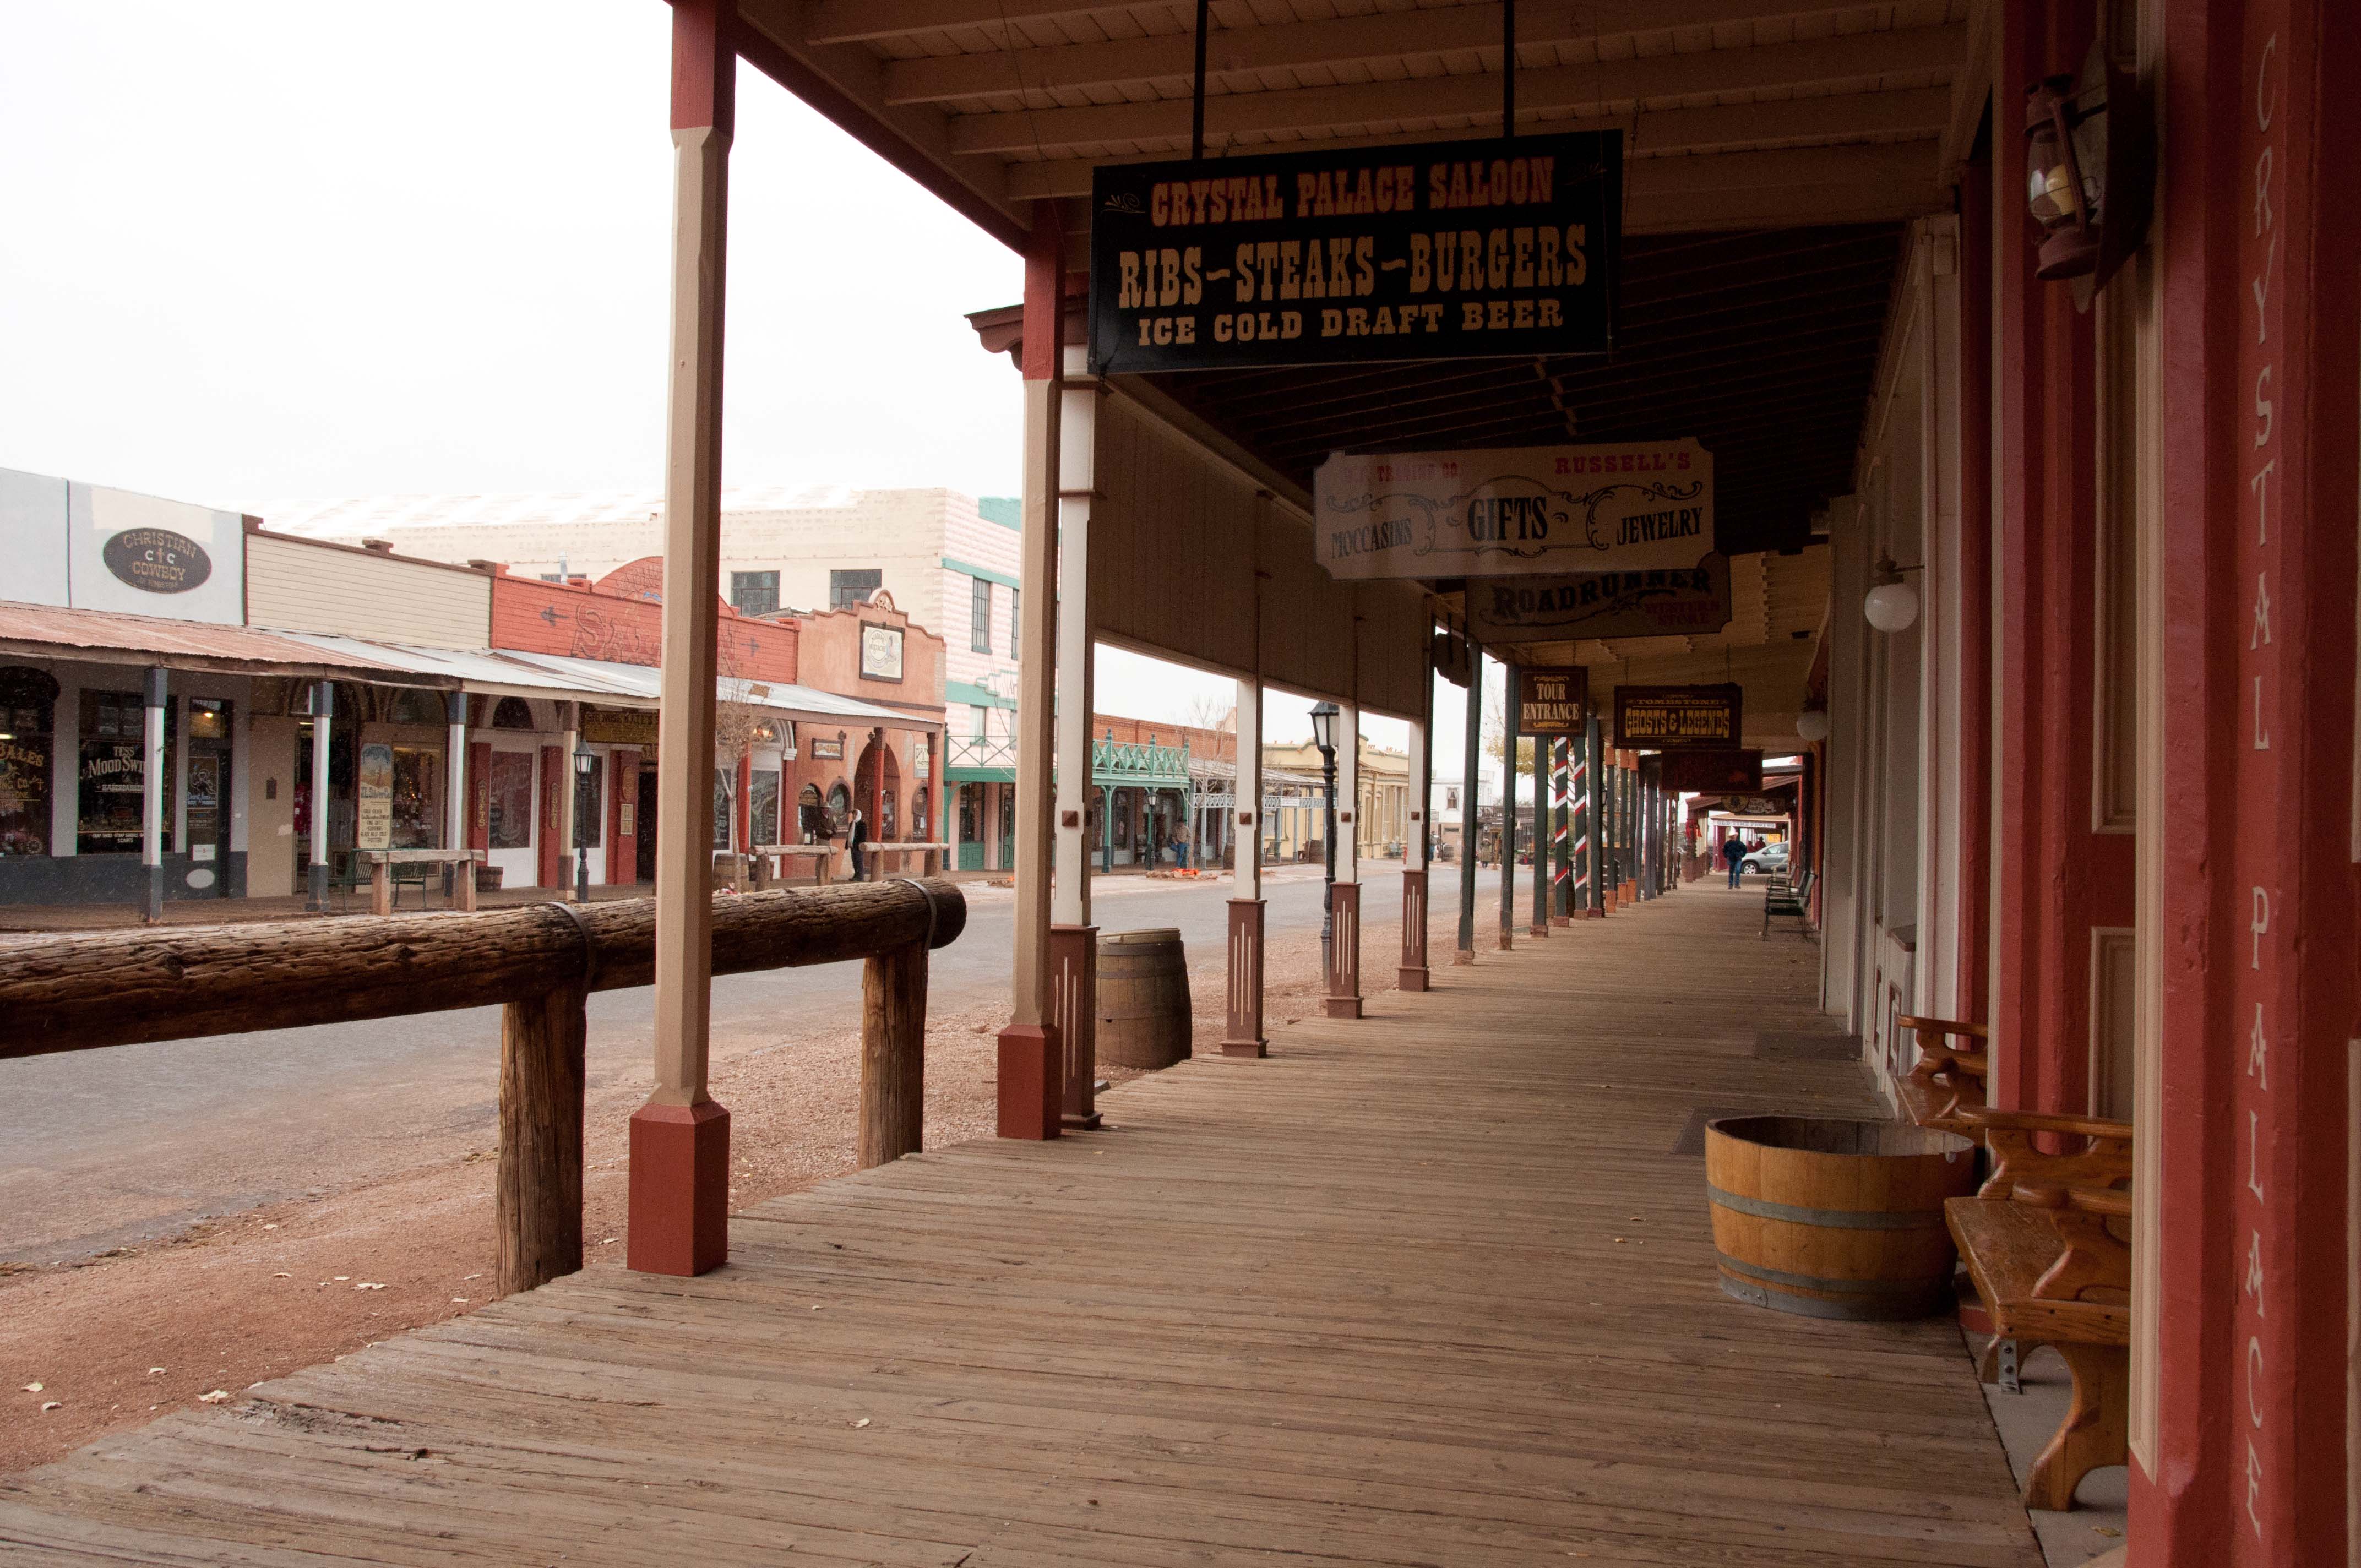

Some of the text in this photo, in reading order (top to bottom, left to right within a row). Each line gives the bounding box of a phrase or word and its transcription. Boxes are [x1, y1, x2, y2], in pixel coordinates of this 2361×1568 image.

[1151, 156, 1554, 227] CRYSTAL PALACE SALOON
[1138, 298, 1564, 346] ICE COLD DRAFT BEER
[1555, 452, 1691, 475] RUSSELL'S
[1467, 496, 1549, 543] GIFTS
[1616, 506, 1704, 546] JEWELRY
[123, 531, 197, 559] CHRISTIAN
[1330, 518, 1413, 559] MOCCASINS
[132, 561, 186, 582] COWBOY
[1492, 568, 1713, 621] ROADRUNNER
[1537, 683, 1566, 700] TOUR
[1522, 703, 1579, 720] ENTRANCE
[1625, 707, 1667, 738] GHOSTS
[1679, 708, 1730, 738] LEGENDS
[113, 746, 135, 757] TESS
[89, 758, 122, 777] MOOD
[2245, 31, 2284, 1540] CRYSTAL PALACE
